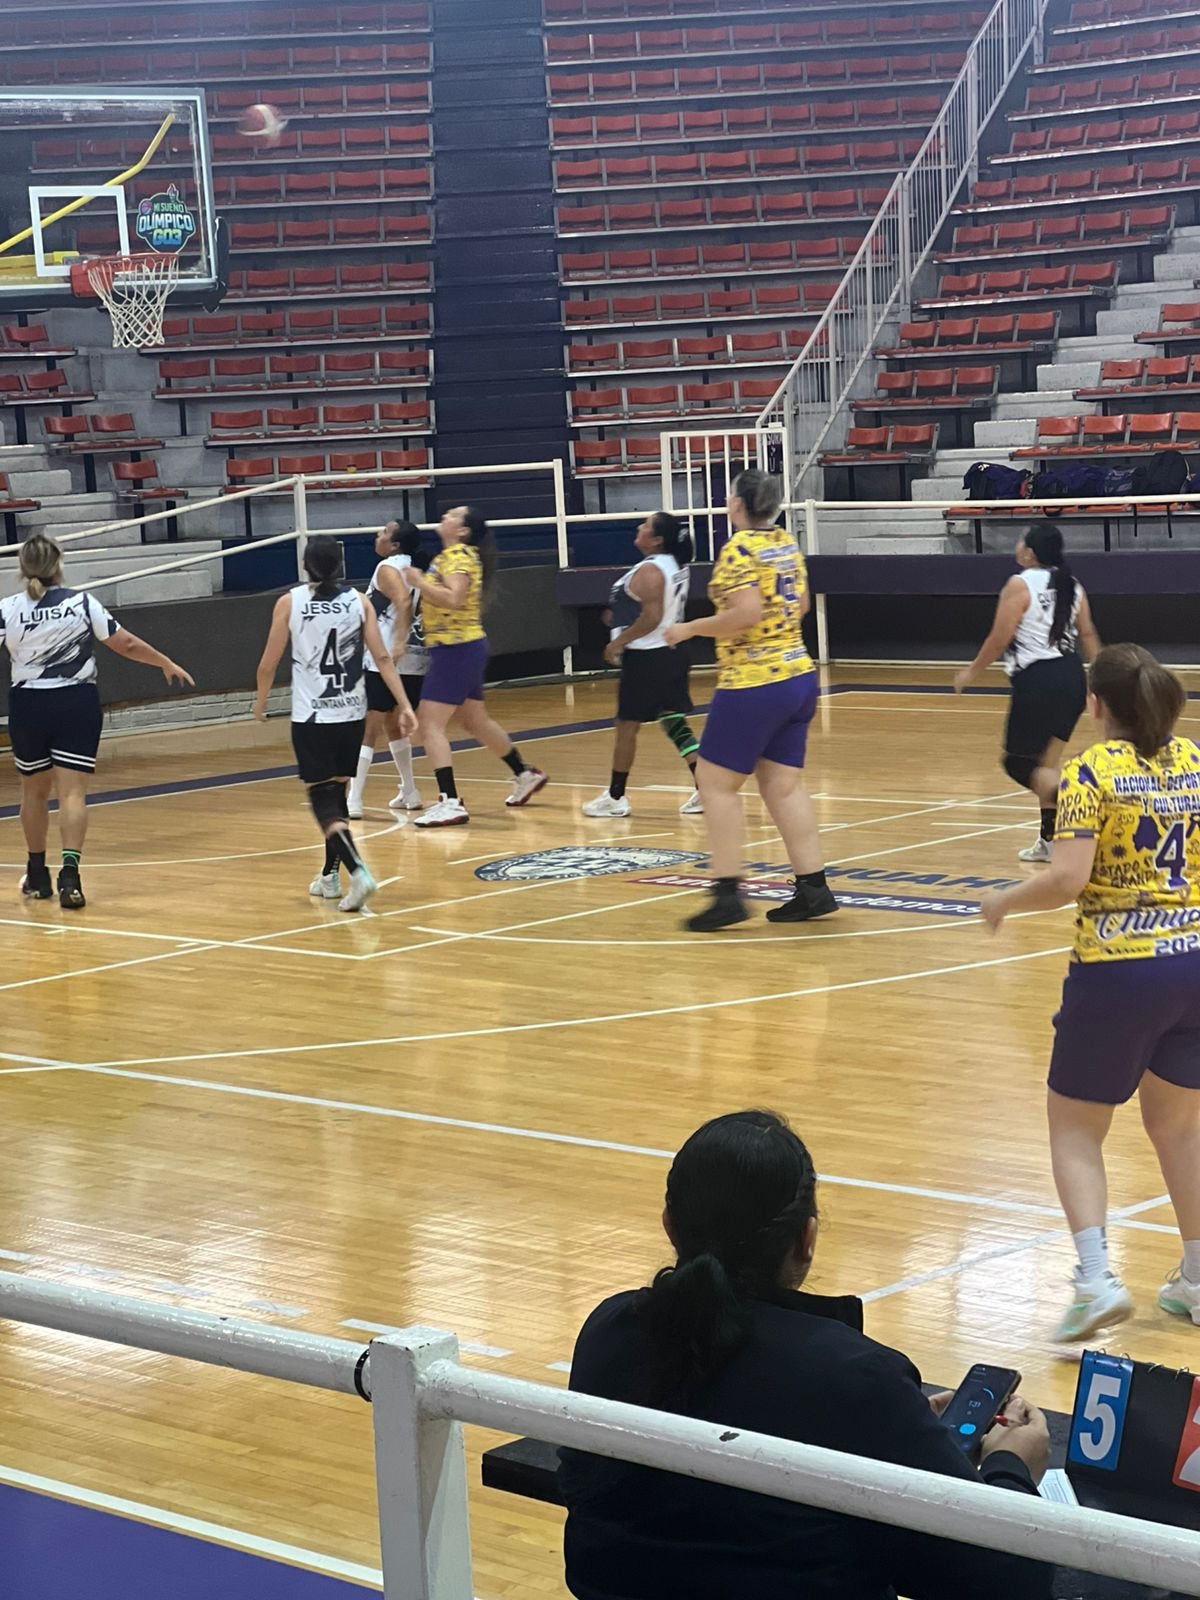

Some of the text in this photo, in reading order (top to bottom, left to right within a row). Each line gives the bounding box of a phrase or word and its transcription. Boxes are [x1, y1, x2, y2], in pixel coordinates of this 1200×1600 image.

[139, 212, 193, 233] OLÍMPICO
[20, 606, 76, 624] LUISA
[301, 602, 352, 615] JESSY
[319, 627, 347, 689] 4
[311, 699, 346, 710] QUINTANA
[1113, 775, 1163, 794] NACIONAL
[1142, 796, 1149, 815] Y
[1154, 822, 1187, 888] 4
[1079, 1373, 1122, 1461] 5
